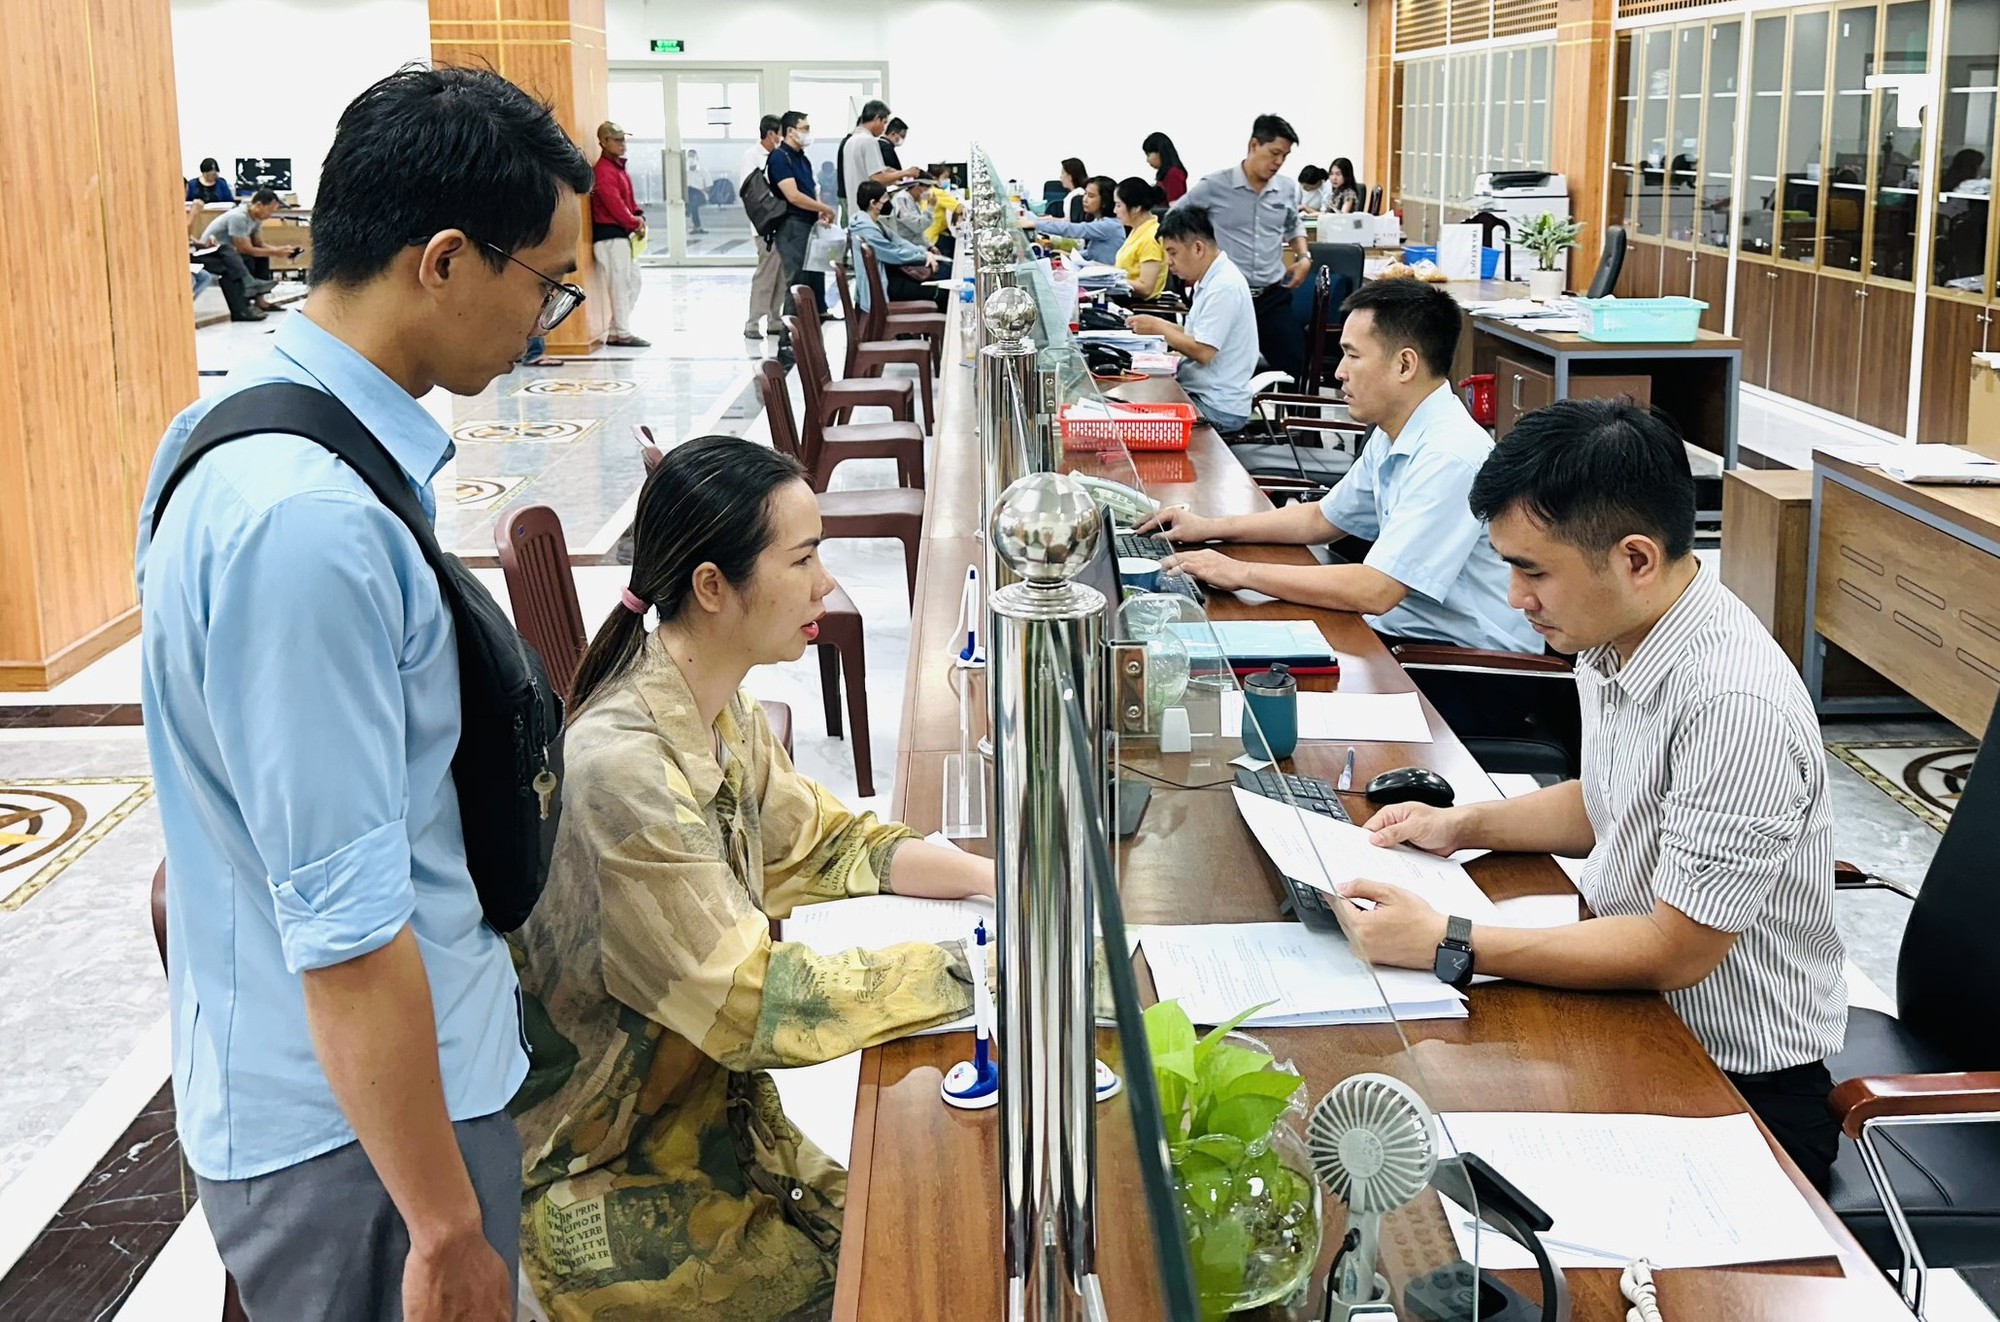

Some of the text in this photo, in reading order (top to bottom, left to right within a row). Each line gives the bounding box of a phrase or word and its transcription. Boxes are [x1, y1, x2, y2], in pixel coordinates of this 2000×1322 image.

[590, 1213, 602, 1224] ER
[576, 1226, 603, 1240] VERB
[582, 1240, 595, 1251] ET
[598, 1250, 610, 1259] ER
